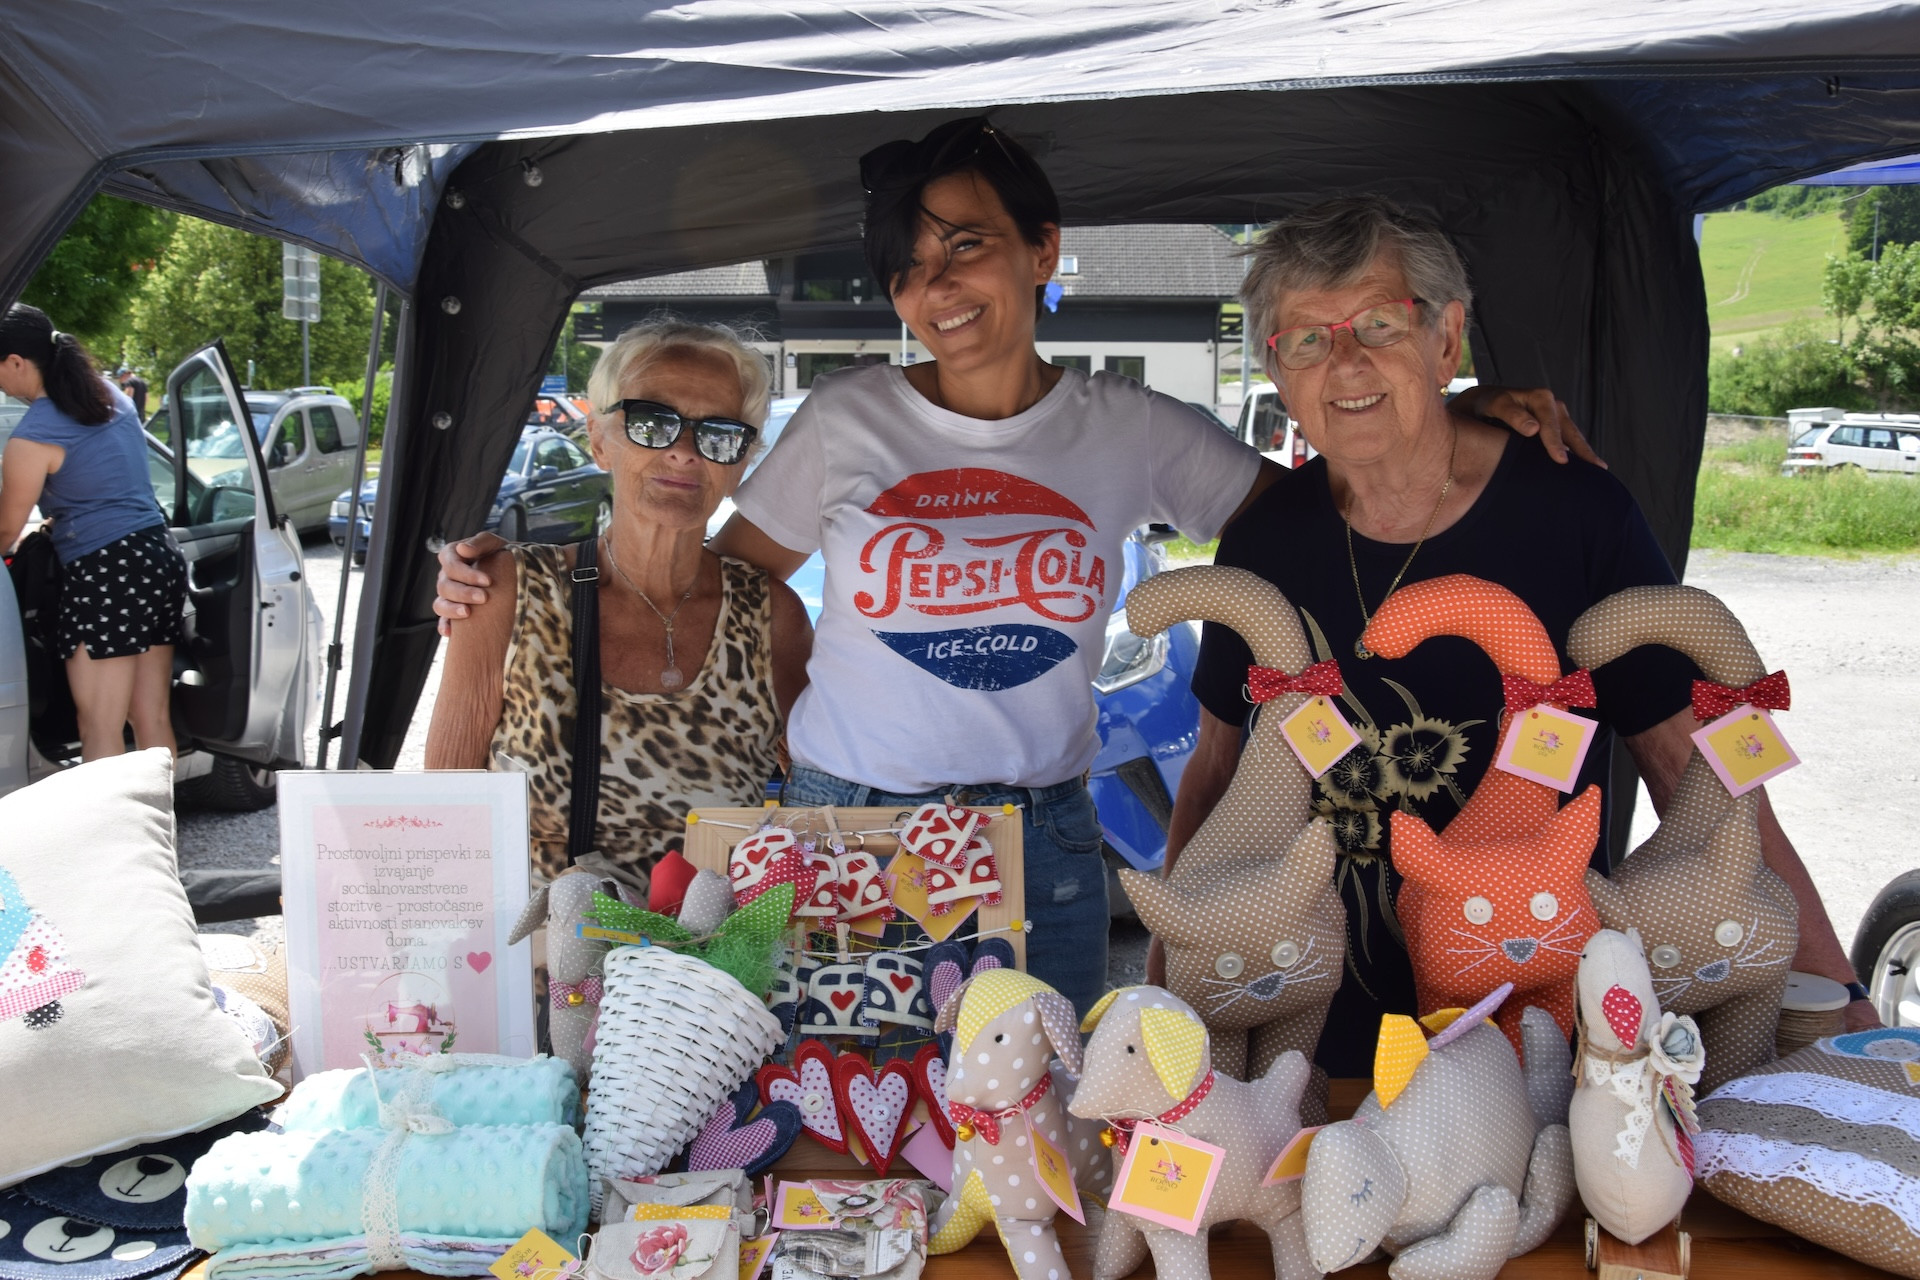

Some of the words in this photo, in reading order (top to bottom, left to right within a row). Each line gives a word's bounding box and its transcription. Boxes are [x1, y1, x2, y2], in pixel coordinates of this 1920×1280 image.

[915, 490, 999, 508] DRINK
[926, 634, 1038, 660] ICE-COLD
[317, 844, 402, 863] Prostovoljni
[407, 844, 471, 863] prispevki
[476, 850, 491, 860] za
[374, 865, 434, 880] izvajanje
[342, 879, 468, 895] socialnovarstvene
[328, 901, 382, 912] storitve
[398, 899, 484, 915] prostočasne
[328, 914, 398, 930] aktivnosti
[401, 914, 484, 930] stanovalcev
[386, 931, 427, 947] doma.
[454, 956, 463, 970] S
